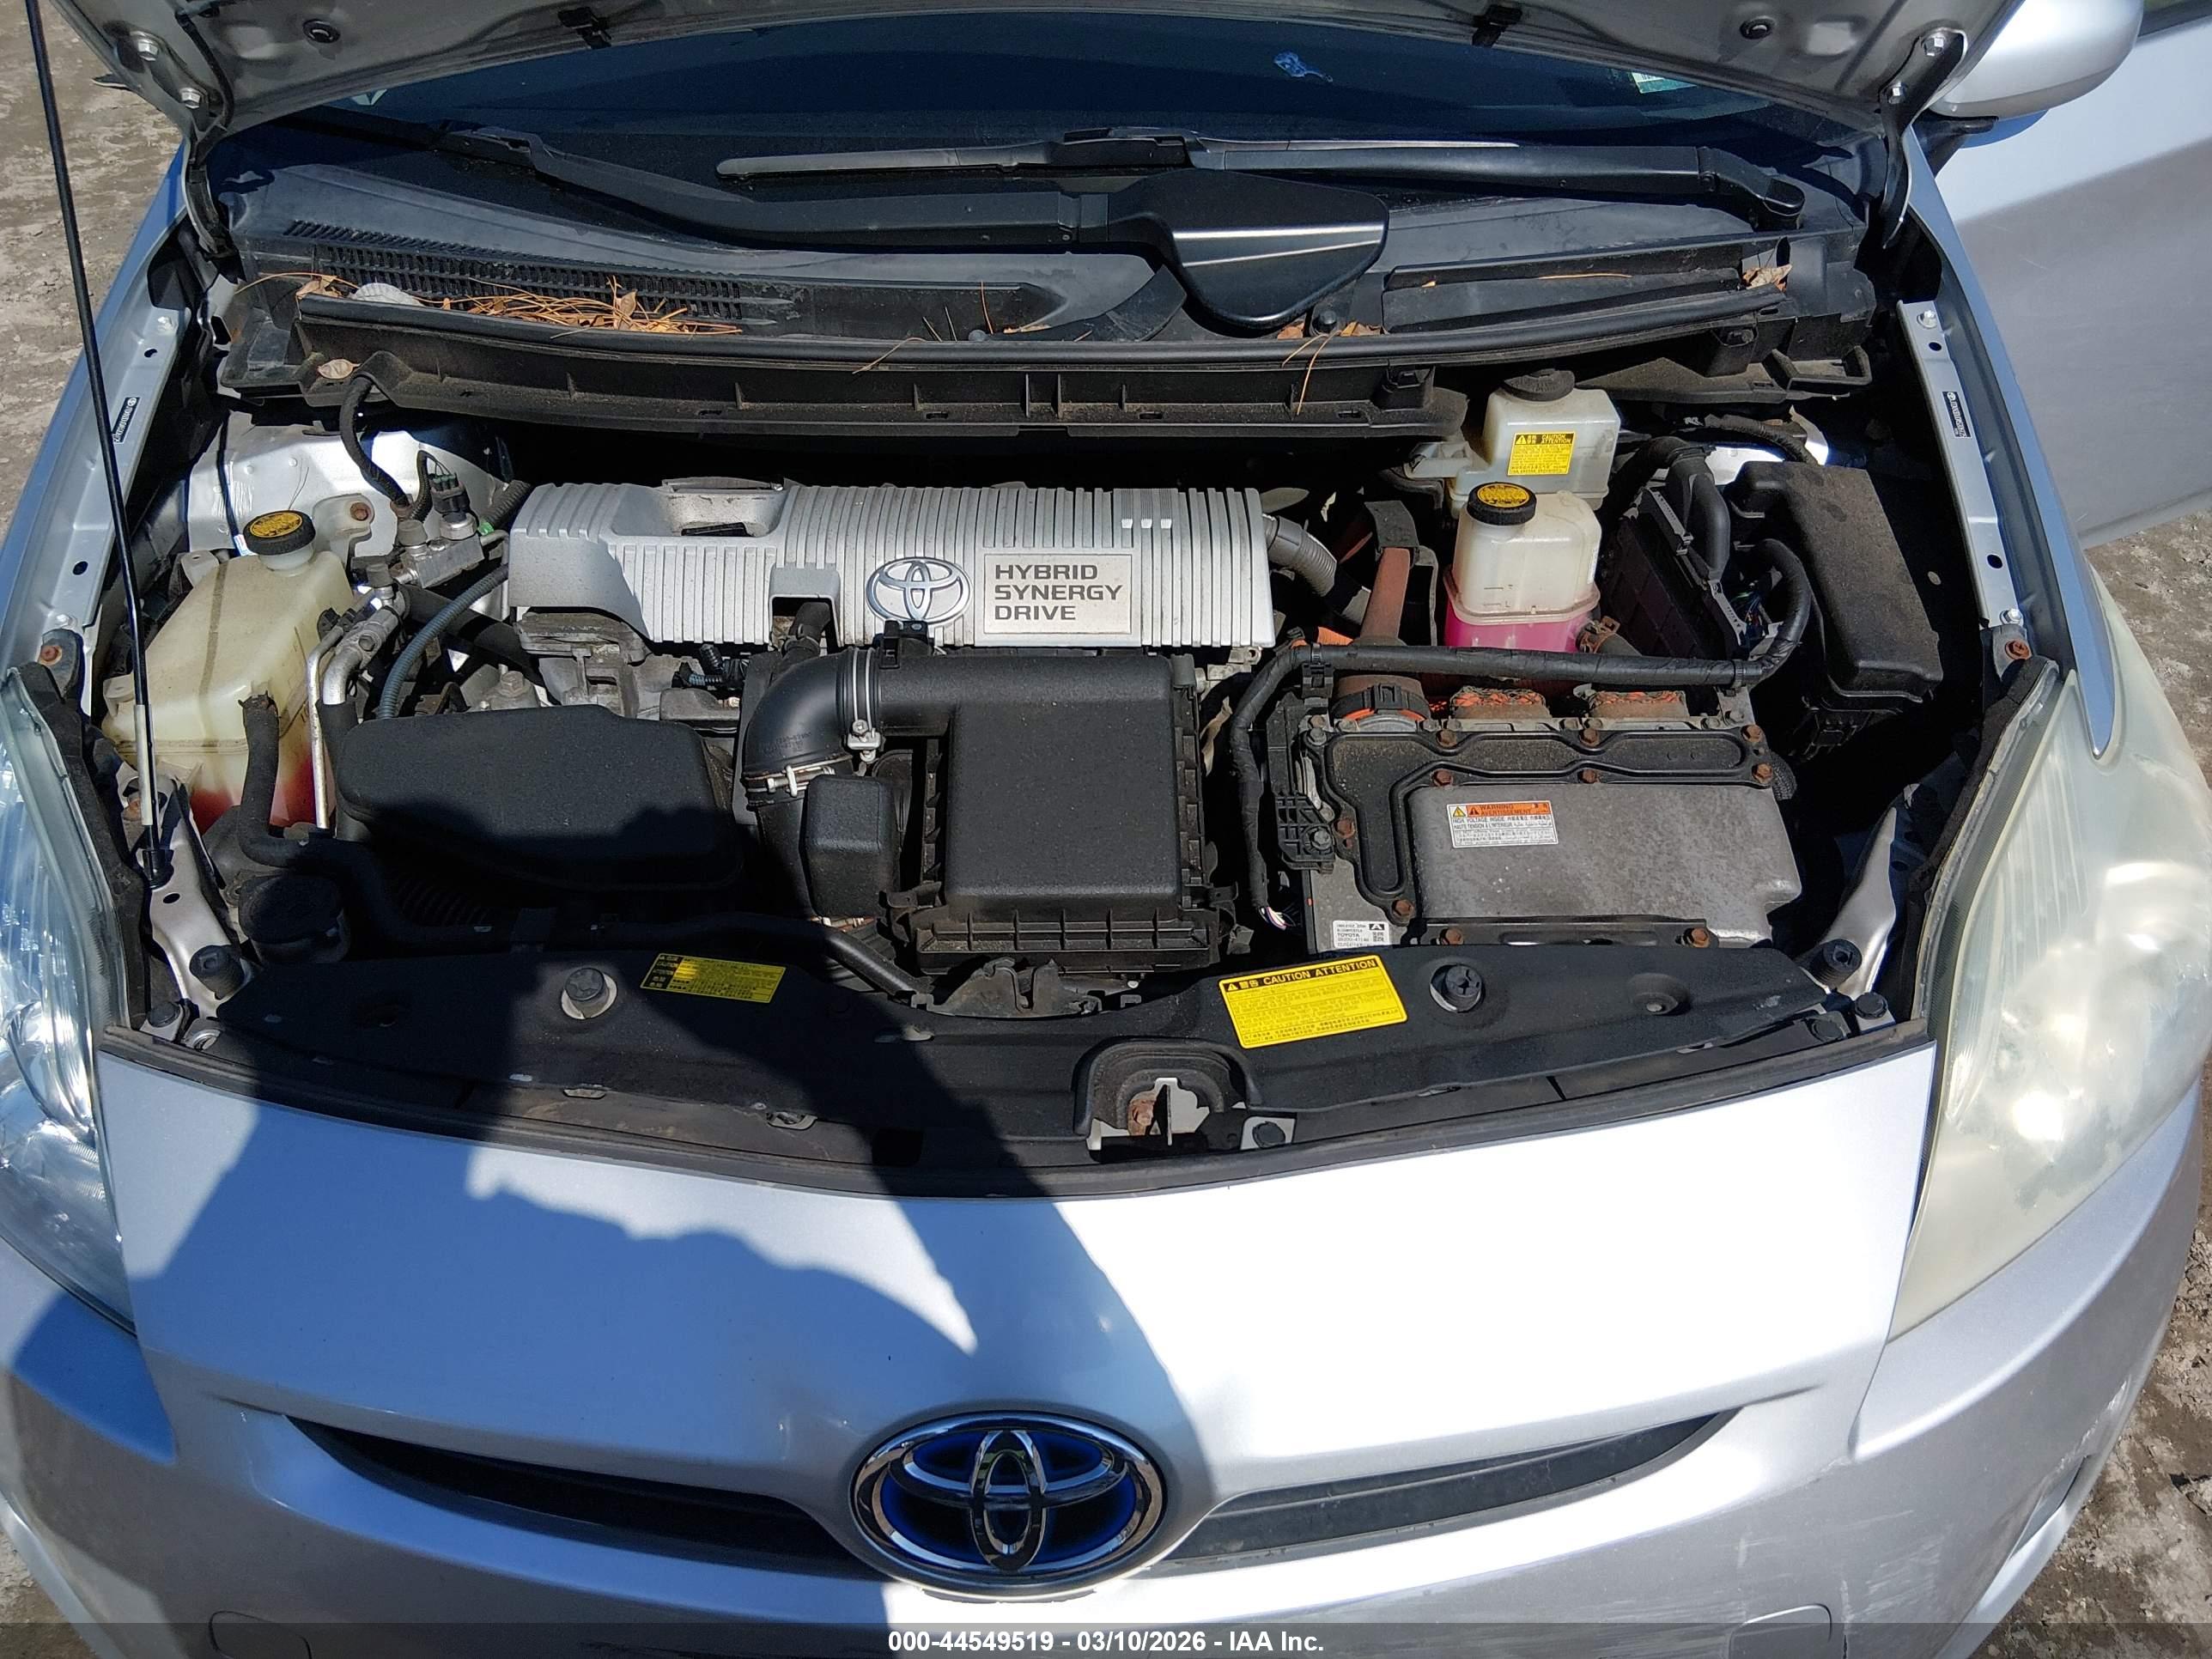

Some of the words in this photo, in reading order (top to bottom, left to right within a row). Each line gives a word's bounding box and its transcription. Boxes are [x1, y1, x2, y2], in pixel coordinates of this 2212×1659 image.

[995, 564, 1098, 580] HYBRID
[994, 585, 1123, 600] SYNERGY
[994, 605, 1077, 620] DRIVE
[1263, 970, 1310, 986] CAUTION
[1315, 959, 1376, 978] ATTENTION
